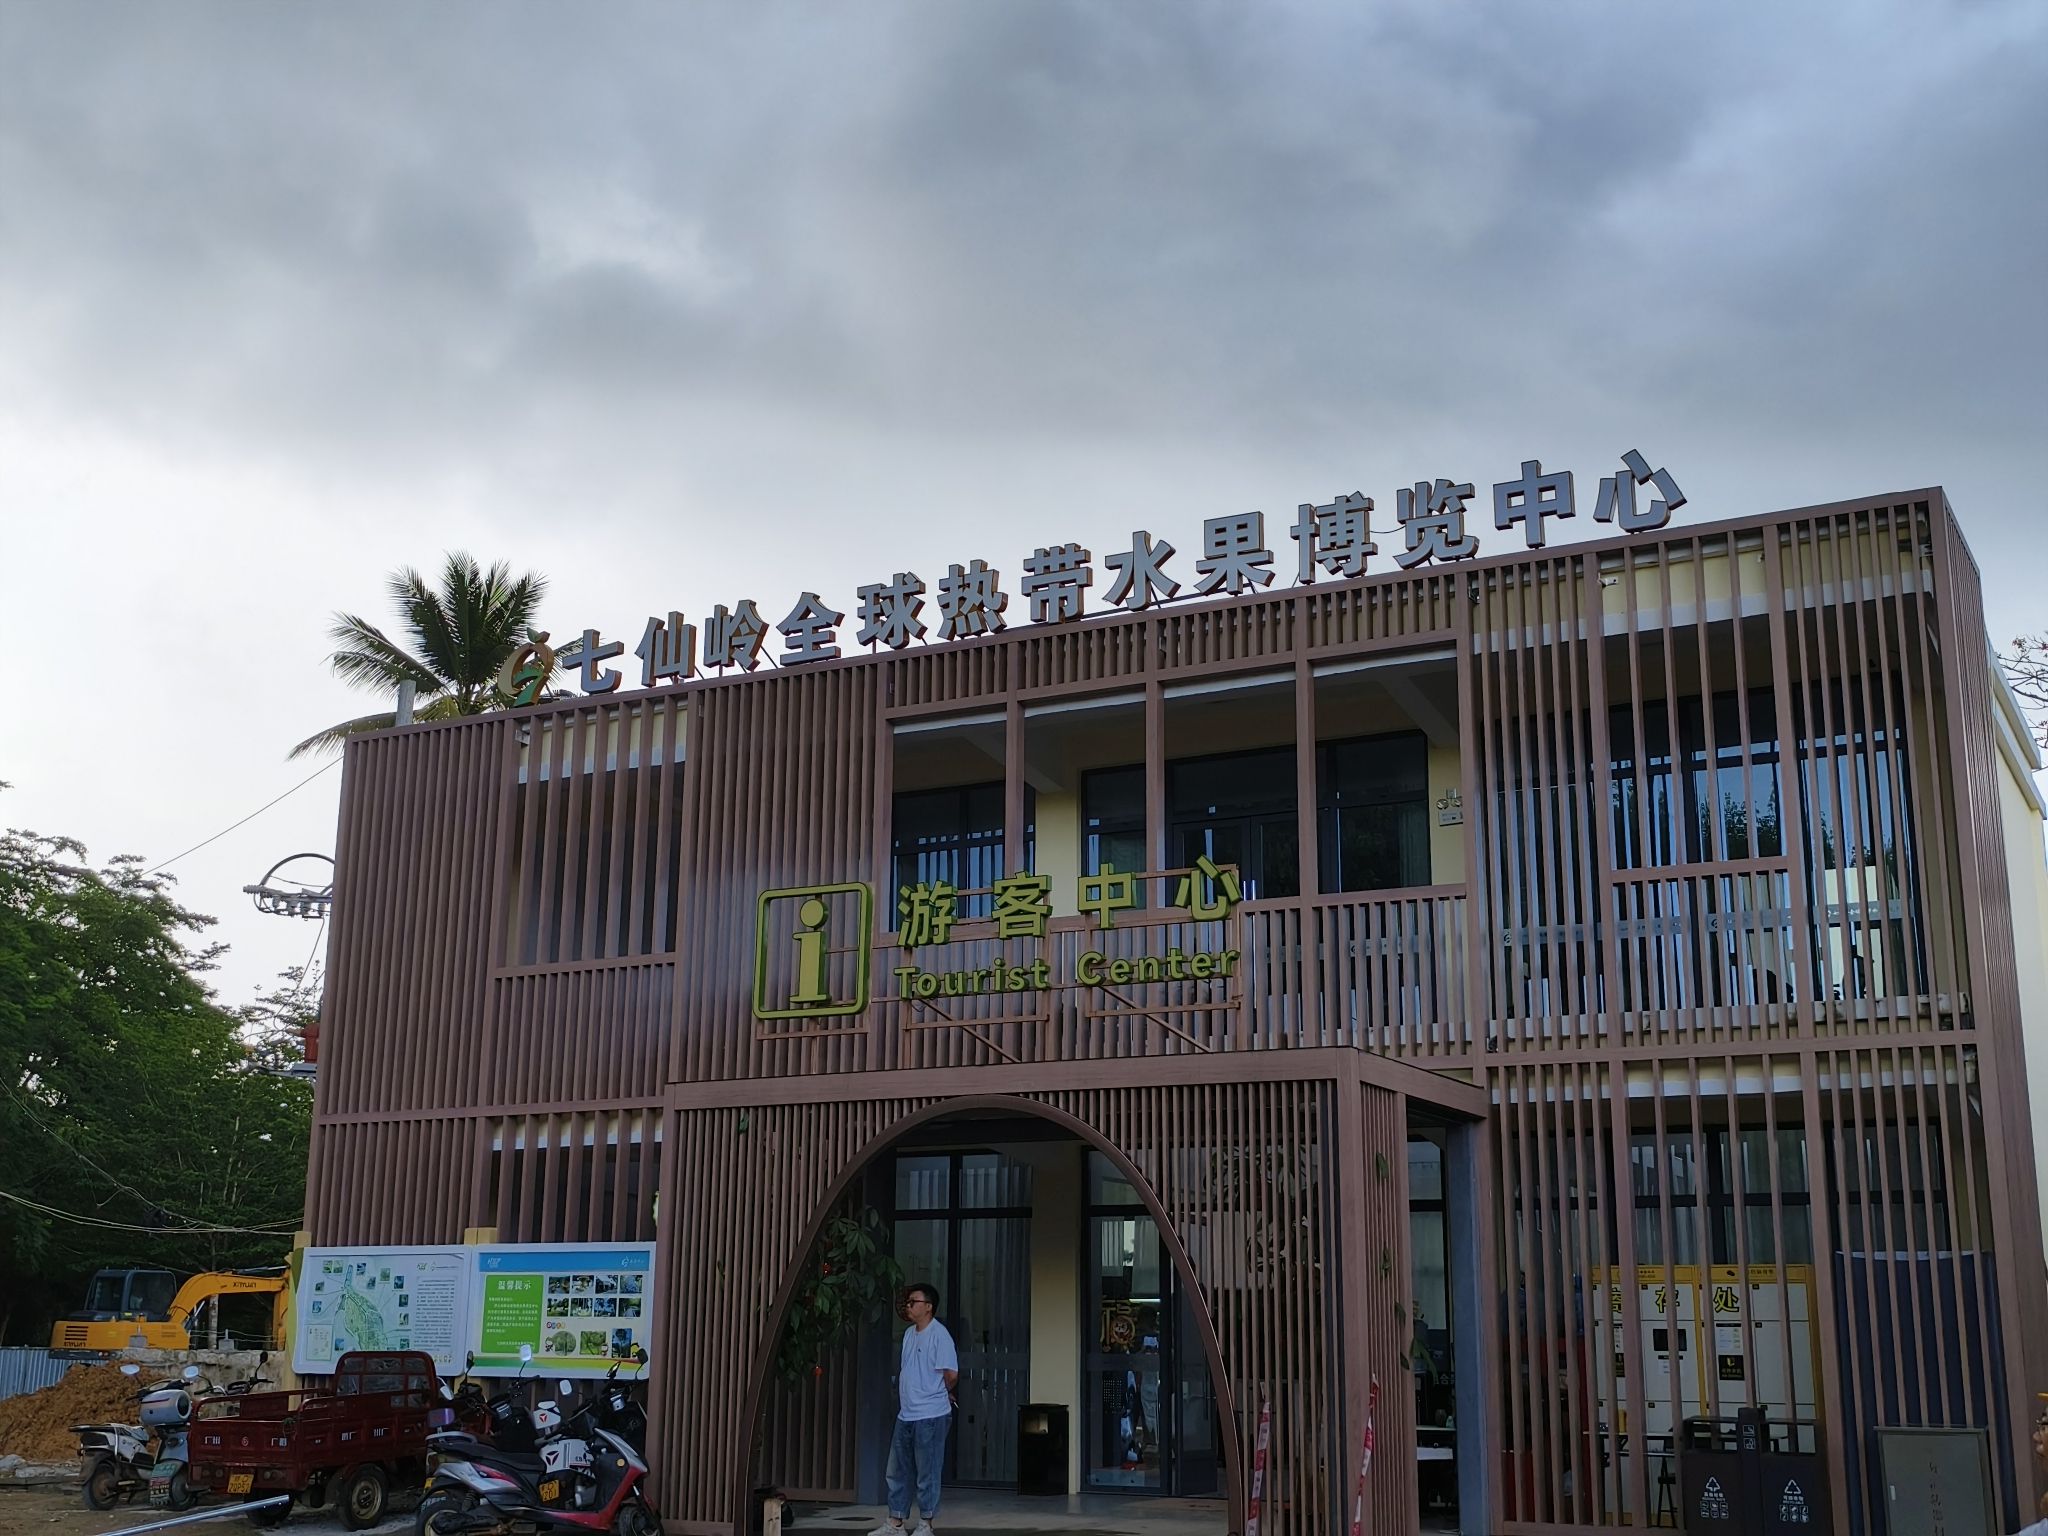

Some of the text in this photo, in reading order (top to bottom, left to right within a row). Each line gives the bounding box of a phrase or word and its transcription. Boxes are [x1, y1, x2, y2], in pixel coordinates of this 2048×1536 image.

[562, 448, 1688, 695] 七仙岭全球热带水果博览中心
[896, 855, 1244, 948] 游客中心
[893, 946, 1240, 1000] Tourist Center
